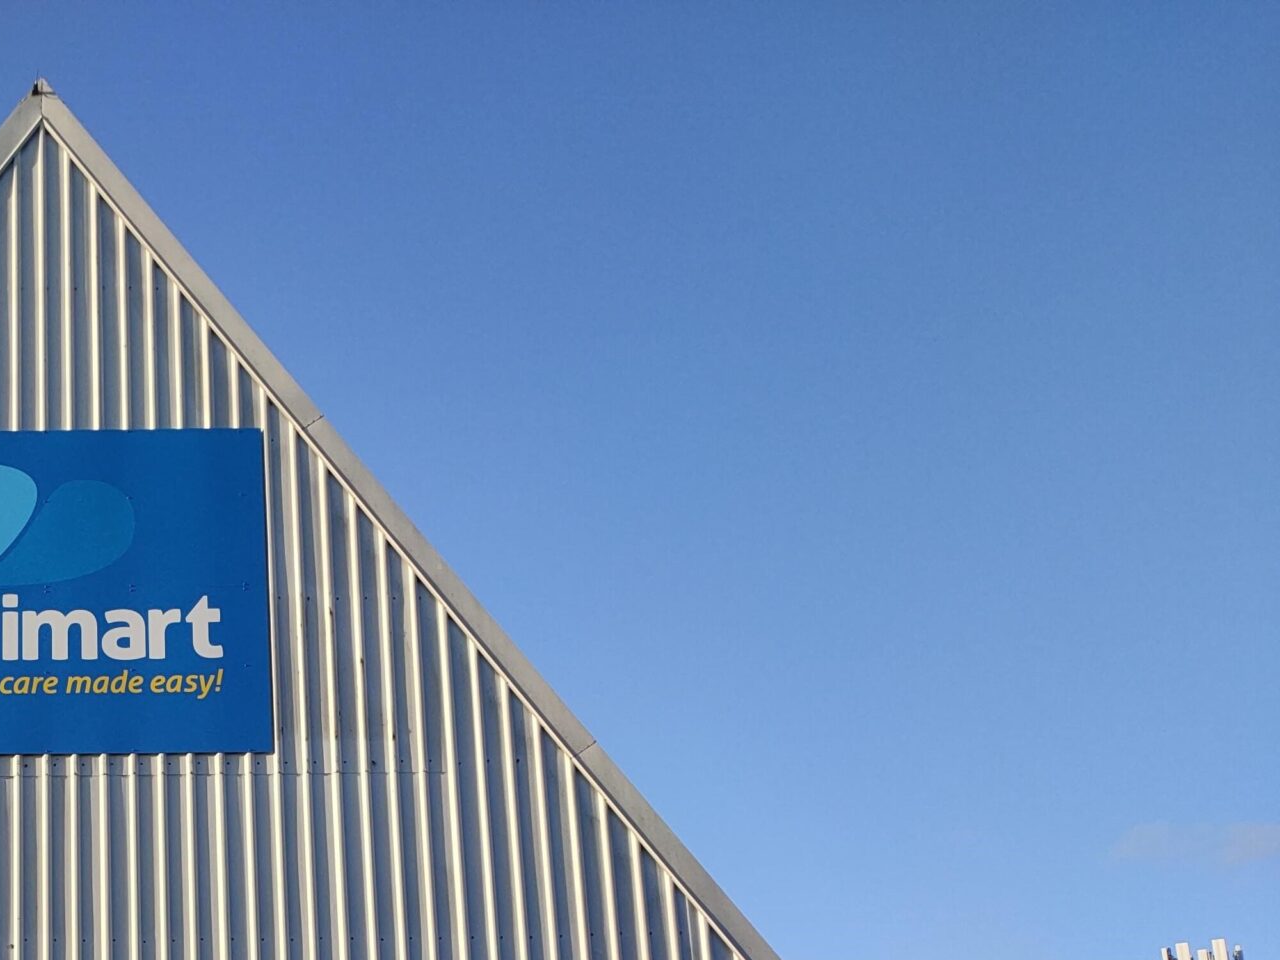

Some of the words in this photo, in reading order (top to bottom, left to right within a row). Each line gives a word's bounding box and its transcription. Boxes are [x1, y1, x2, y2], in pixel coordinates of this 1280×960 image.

[0, 676, 58, 694] care
[66, 670, 143, 693] made
[150, 669, 223, 699] easy!
